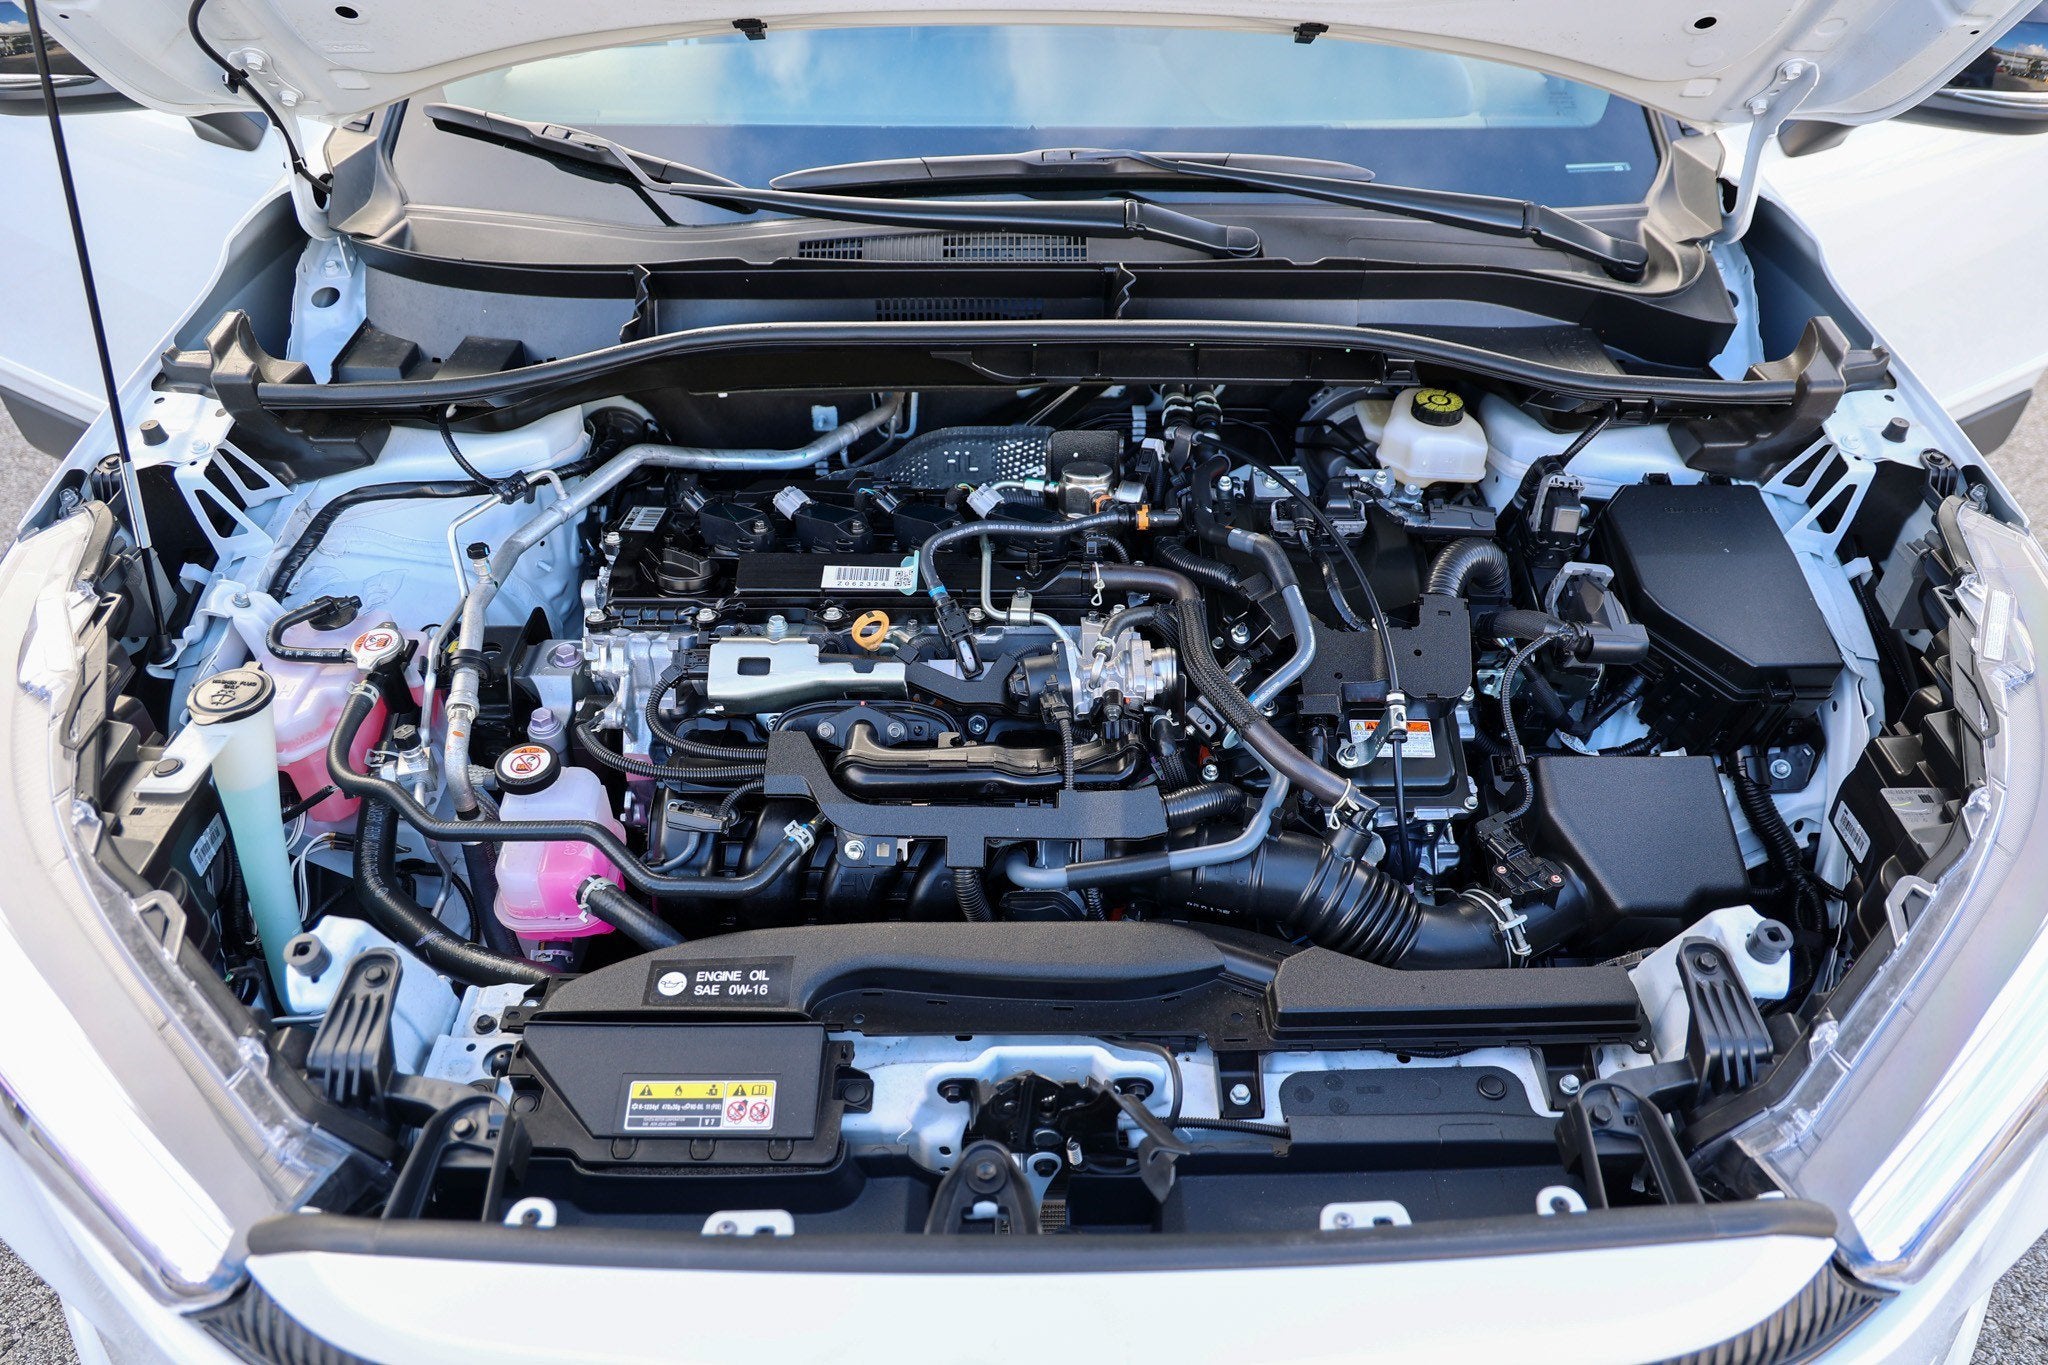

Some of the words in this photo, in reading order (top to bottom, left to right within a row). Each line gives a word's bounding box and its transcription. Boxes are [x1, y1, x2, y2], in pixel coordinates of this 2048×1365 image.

[696, 971, 742, 982] ENGINE
[749, 970, 770, 981] OIL
[693, 984, 720, 996] SAE
[728, 984, 769, 995] 0W-16
